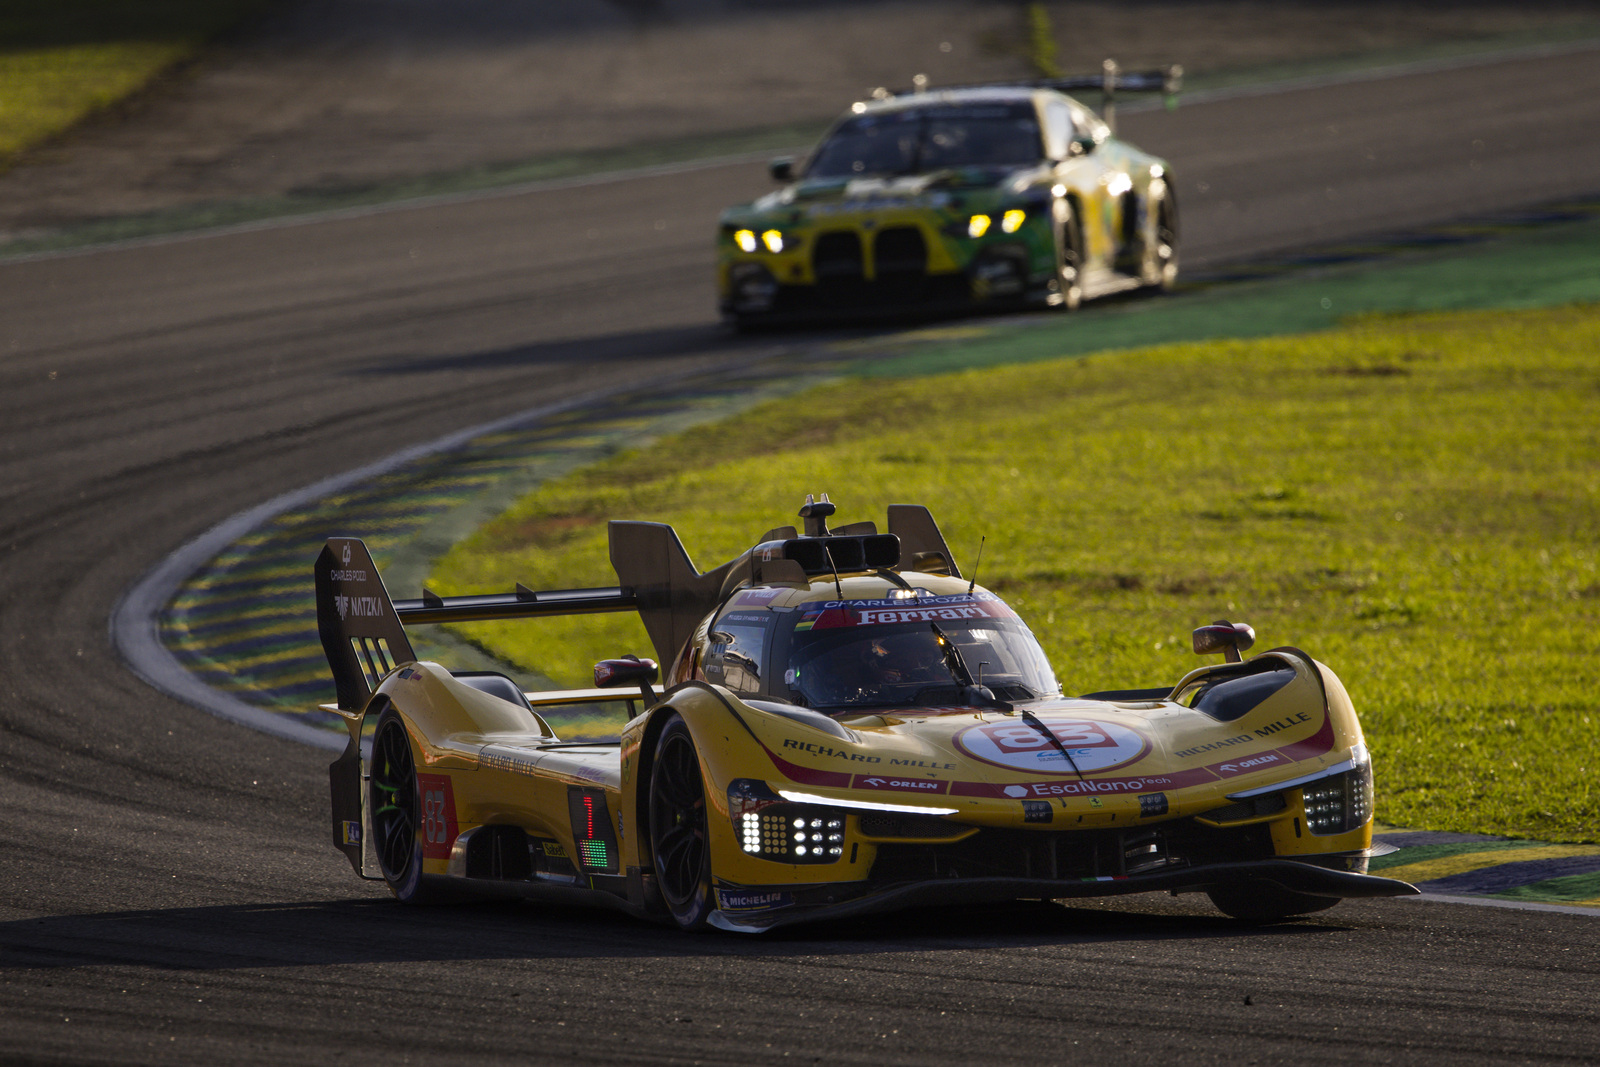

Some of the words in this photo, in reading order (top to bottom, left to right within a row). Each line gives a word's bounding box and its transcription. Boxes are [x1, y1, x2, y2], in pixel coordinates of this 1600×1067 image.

[330, 569, 353, 581] CHARLES
[353, 570, 367, 581] POZZI
[351, 596, 384, 616] NATZKA
[856, 604, 991, 625] Ferrari
[993, 724, 1106, 748] 83
[1174, 734, 1254, 758] RICHARD
[1254, 711, 1313, 738] MILLE
[480, 752, 512, 773] RICHARD
[512, 758, 536, 778] MILLE
[783, 739, 881, 764] RICHARD
[889, 758, 957, 771] MILLE
[1238, 754, 1279, 769] ORLEN
[889, 780, 938, 790] ORLEN
[425, 790, 448, 844] 83
[729, 892, 782, 906] MICHELIN
